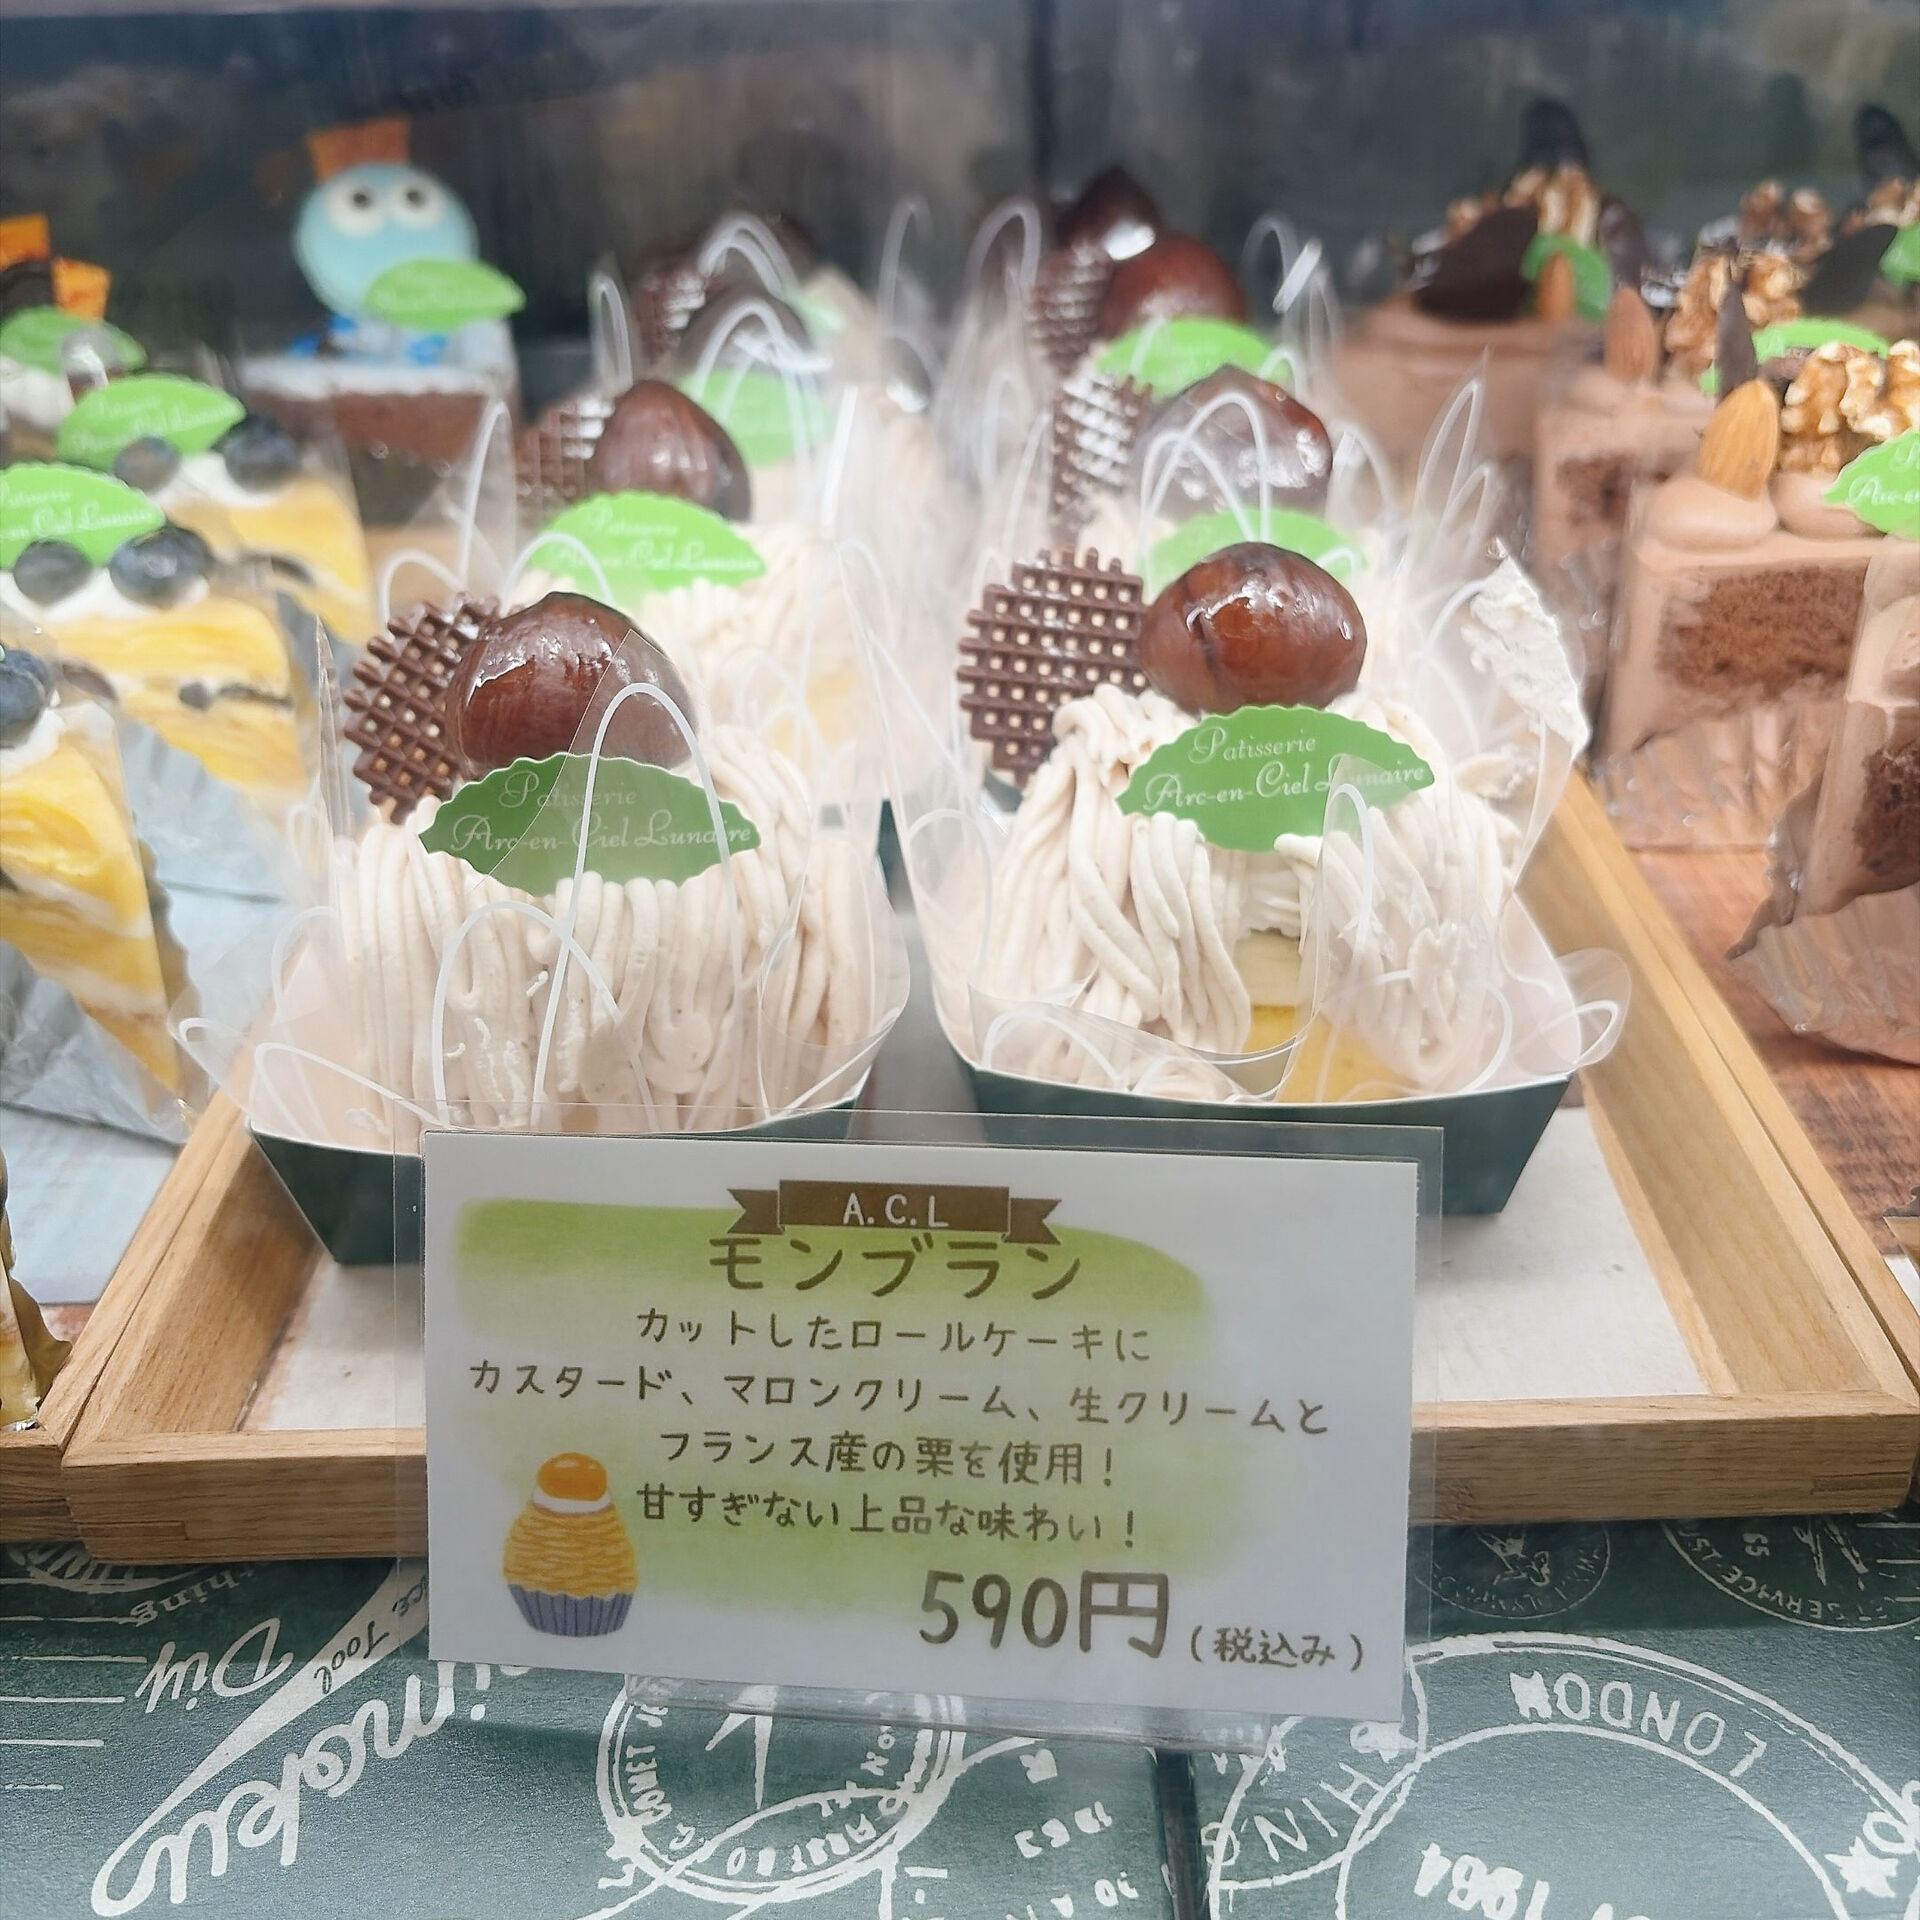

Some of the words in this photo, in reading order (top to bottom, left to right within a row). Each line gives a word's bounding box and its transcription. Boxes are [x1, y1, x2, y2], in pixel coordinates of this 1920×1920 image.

[842, 1191, 949, 1228] A.C.L
[708, 1231, 1081, 1300] モンブラン
[636, 1307, 1151, 1362] カットしたロールケーキに
[469, 1359, 1329, 1434] カスタード、マロンクリーム、生クリームと
[660, 1430, 1113, 1488] フランス産の栗を使用！
[636, 1482, 1135, 1549] 甘すぎない上品な味わい！
[919, 1569, 1170, 1659] 590円
[134, 1617, 295, 1713] Diy
[314, 1619, 391, 1694] Tool
